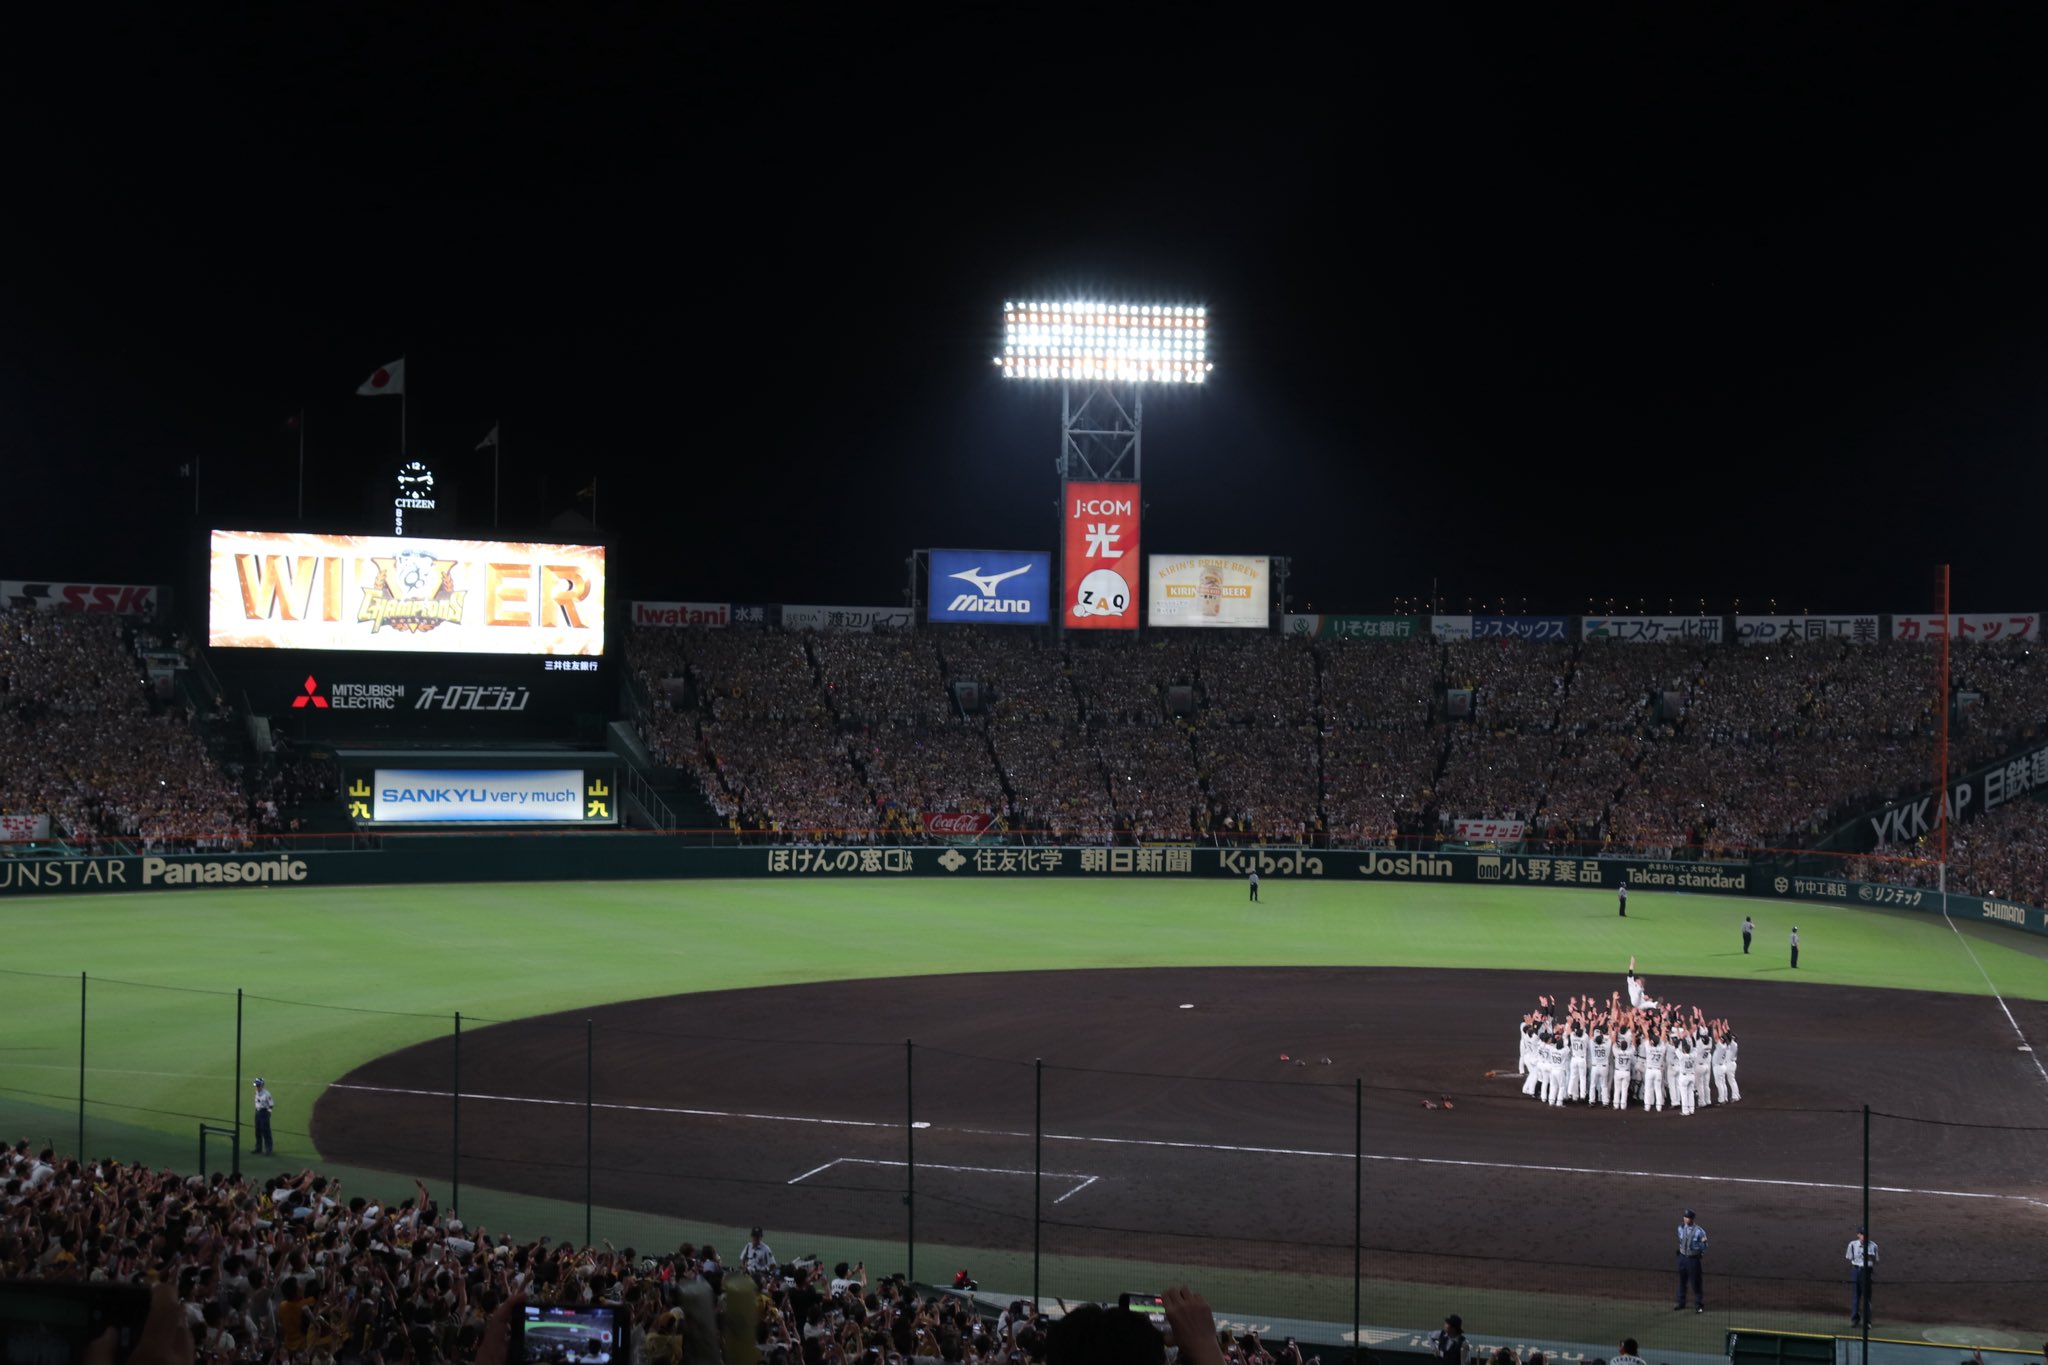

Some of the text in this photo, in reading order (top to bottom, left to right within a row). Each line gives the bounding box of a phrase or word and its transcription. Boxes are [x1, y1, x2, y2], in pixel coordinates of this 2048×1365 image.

[395, 498, 435, 509] CITIZEN
[1074, 500, 1131, 518] J:COM
[1085, 523, 1124, 558] 光
[63, 585, 151, 613] SSK
[1222, 587, 1247, 597] BEER
[637, 604, 726, 625] Iwatani
[1334, 620, 1411, 637] りそな銀行
[1474, 621, 1565, 638] シスメックス
[1611, 619, 1719, 640] エスケー化研
[1780, 619, 1877, 641] 大同工業
[545, 660, 598, 671] 三井住友銀行
[332, 684, 404, 697] MITSUBISHI
[414, 686, 530, 710] オーロラビジョン
[332, 696, 395, 709] ELECTRIC
[349, 779, 371, 819] 山九
[382, 788, 575, 804] SANKYU very much
[587, 779, 609, 818] 山九
[1871, 784, 1971, 845] YKK AP
[1456, 823, 1523, 837] 不二サッシ
[142, 854, 308, 885] Panasonic
[767, 849, 905, 872] ほけんの窓口
[973, 849, 1062, 872] 住友化学
[1081, 848, 1192, 873] 朝日新聞
[1220, 849, 1323, 875] Kubota
[1359, 853, 1452, 877] Joshin
[1502, 859, 1601, 883] 小野薬品
[1626, 867, 1745, 889] Takara standard
[1794, 879, 1847, 897] 竹中工務店
[1875, 886, 1922, 906] リンテック
[1983, 902, 2025, 924] SHIMANO
